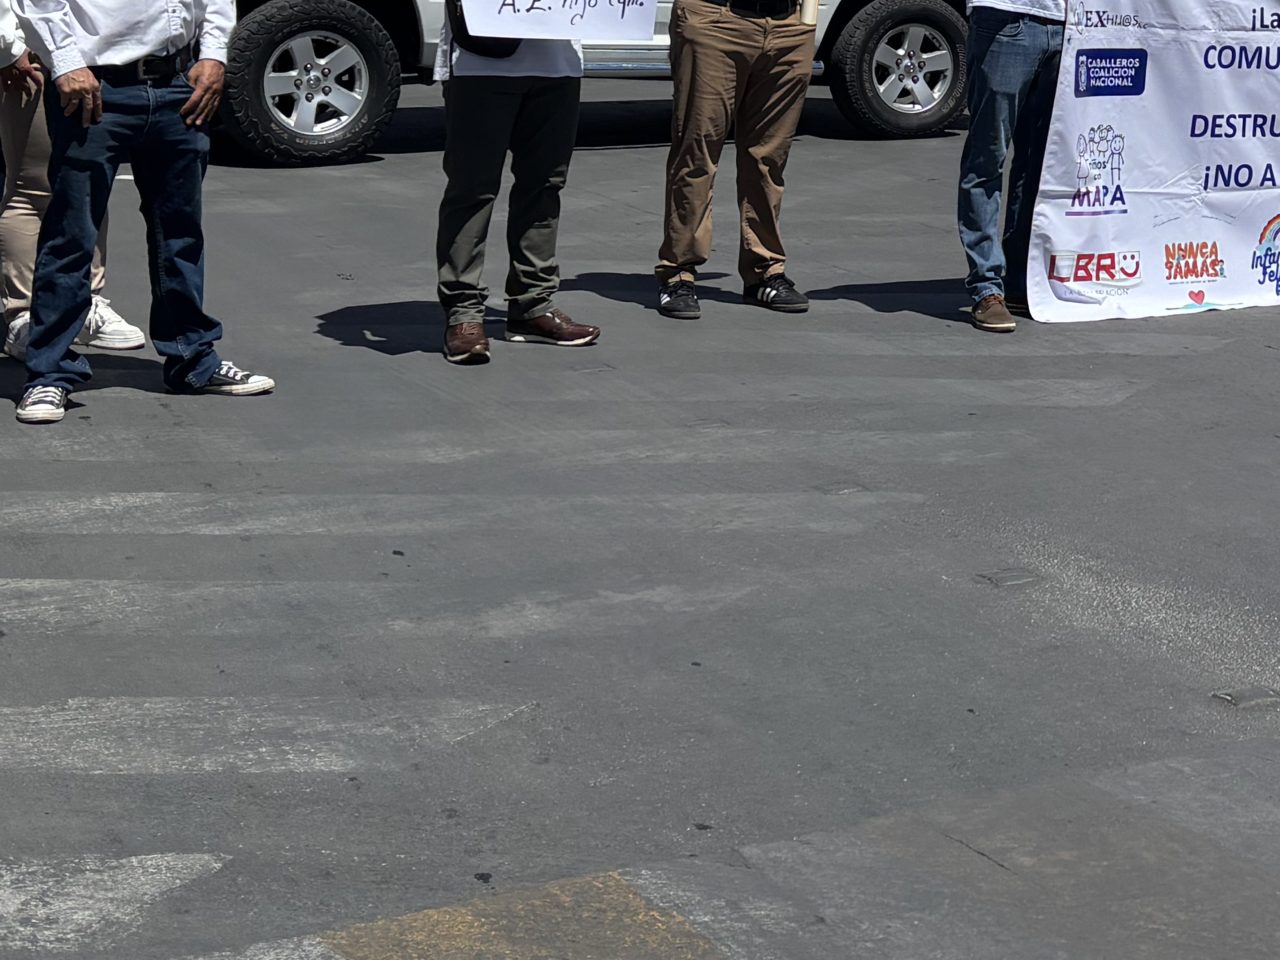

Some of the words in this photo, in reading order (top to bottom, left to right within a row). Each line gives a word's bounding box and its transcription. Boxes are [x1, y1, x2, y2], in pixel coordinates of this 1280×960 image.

[1087, 58, 1140, 68] CABALLEROS
[1090, 67, 1136, 78] COALICION
[1090, 77, 1133, 87] NACIONAL
[1203, 163, 1253, 192] ¡NO
[1260, 163, 1277, 187] A
[1071, 184, 1126, 207] MAPA
[1164, 241, 1218, 260] NUNCA
